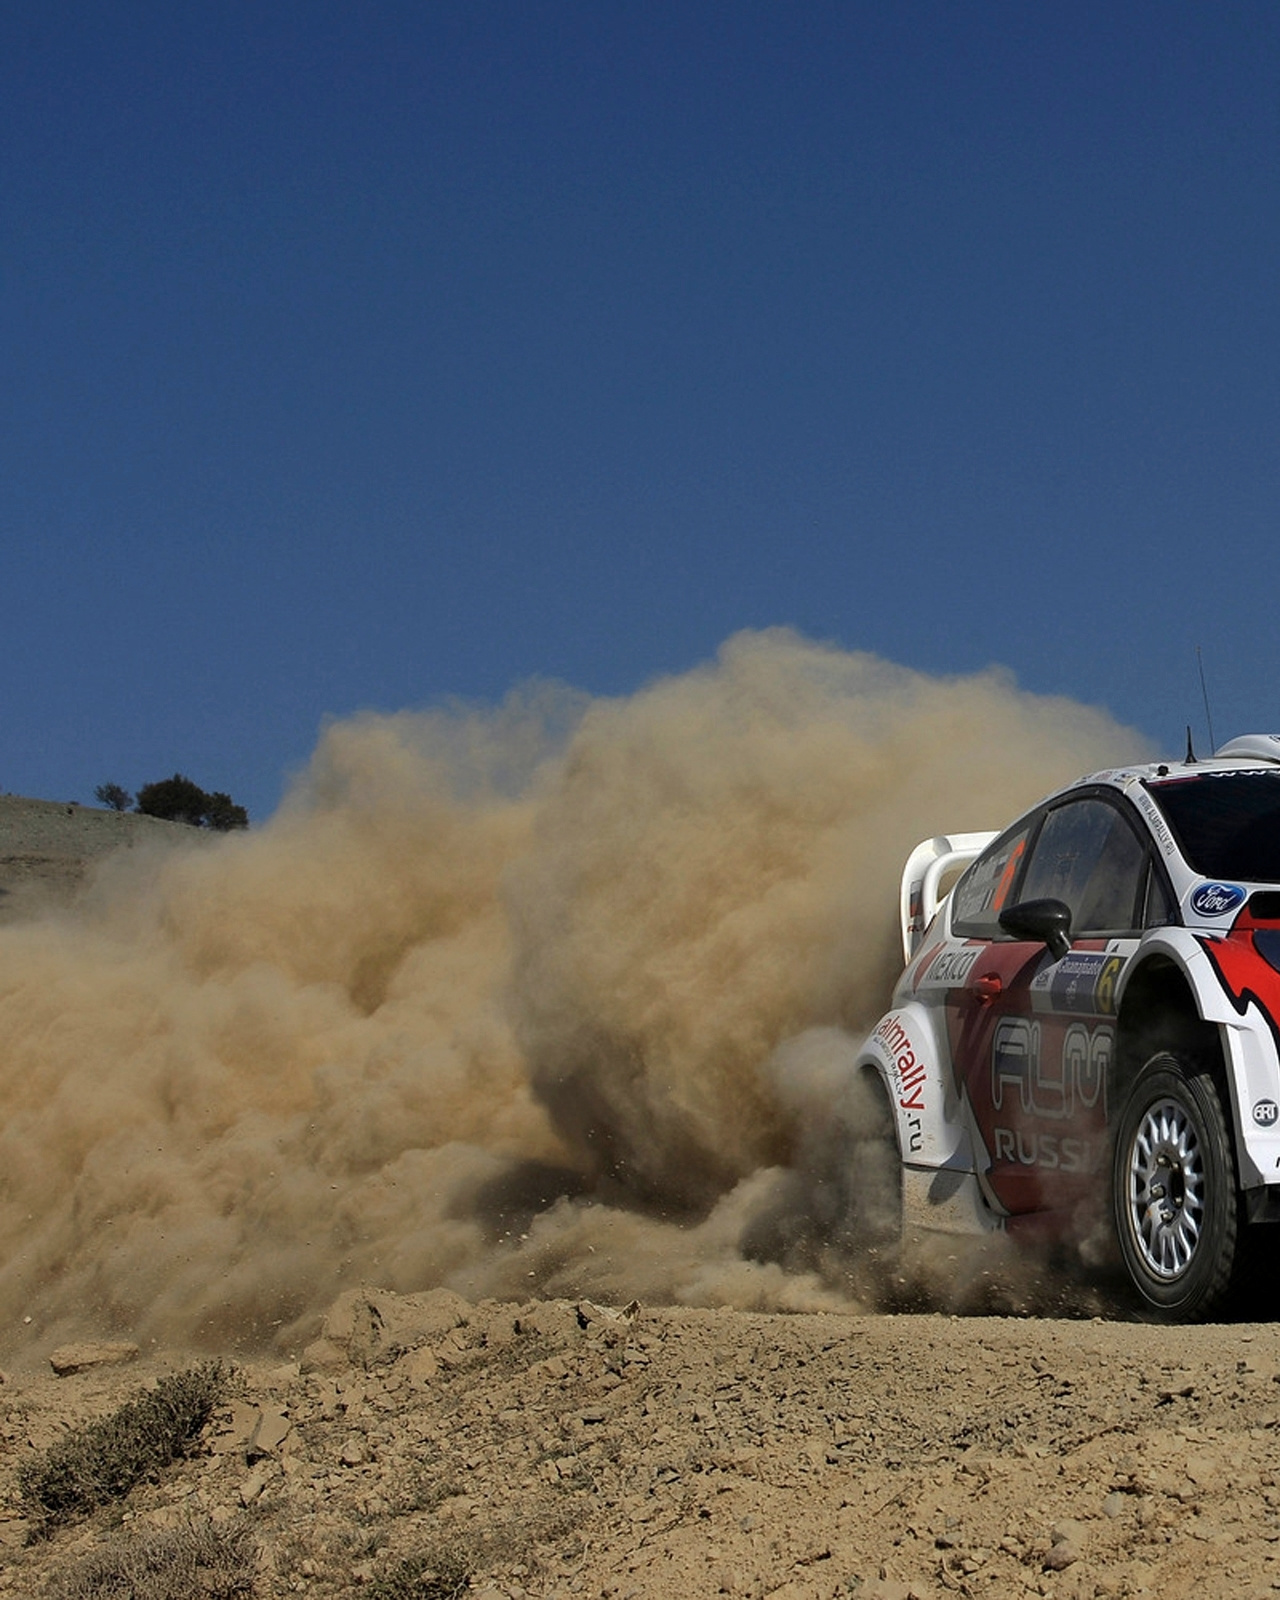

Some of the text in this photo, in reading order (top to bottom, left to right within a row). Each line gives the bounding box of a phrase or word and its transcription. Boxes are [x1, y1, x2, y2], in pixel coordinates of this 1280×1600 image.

[1197, 884, 1237, 910] Ford
[1099, 958, 1120, 1013] 6
[995, 1128, 1107, 1174] RUSSI
[1275, 1157, 1280, 1168] I
